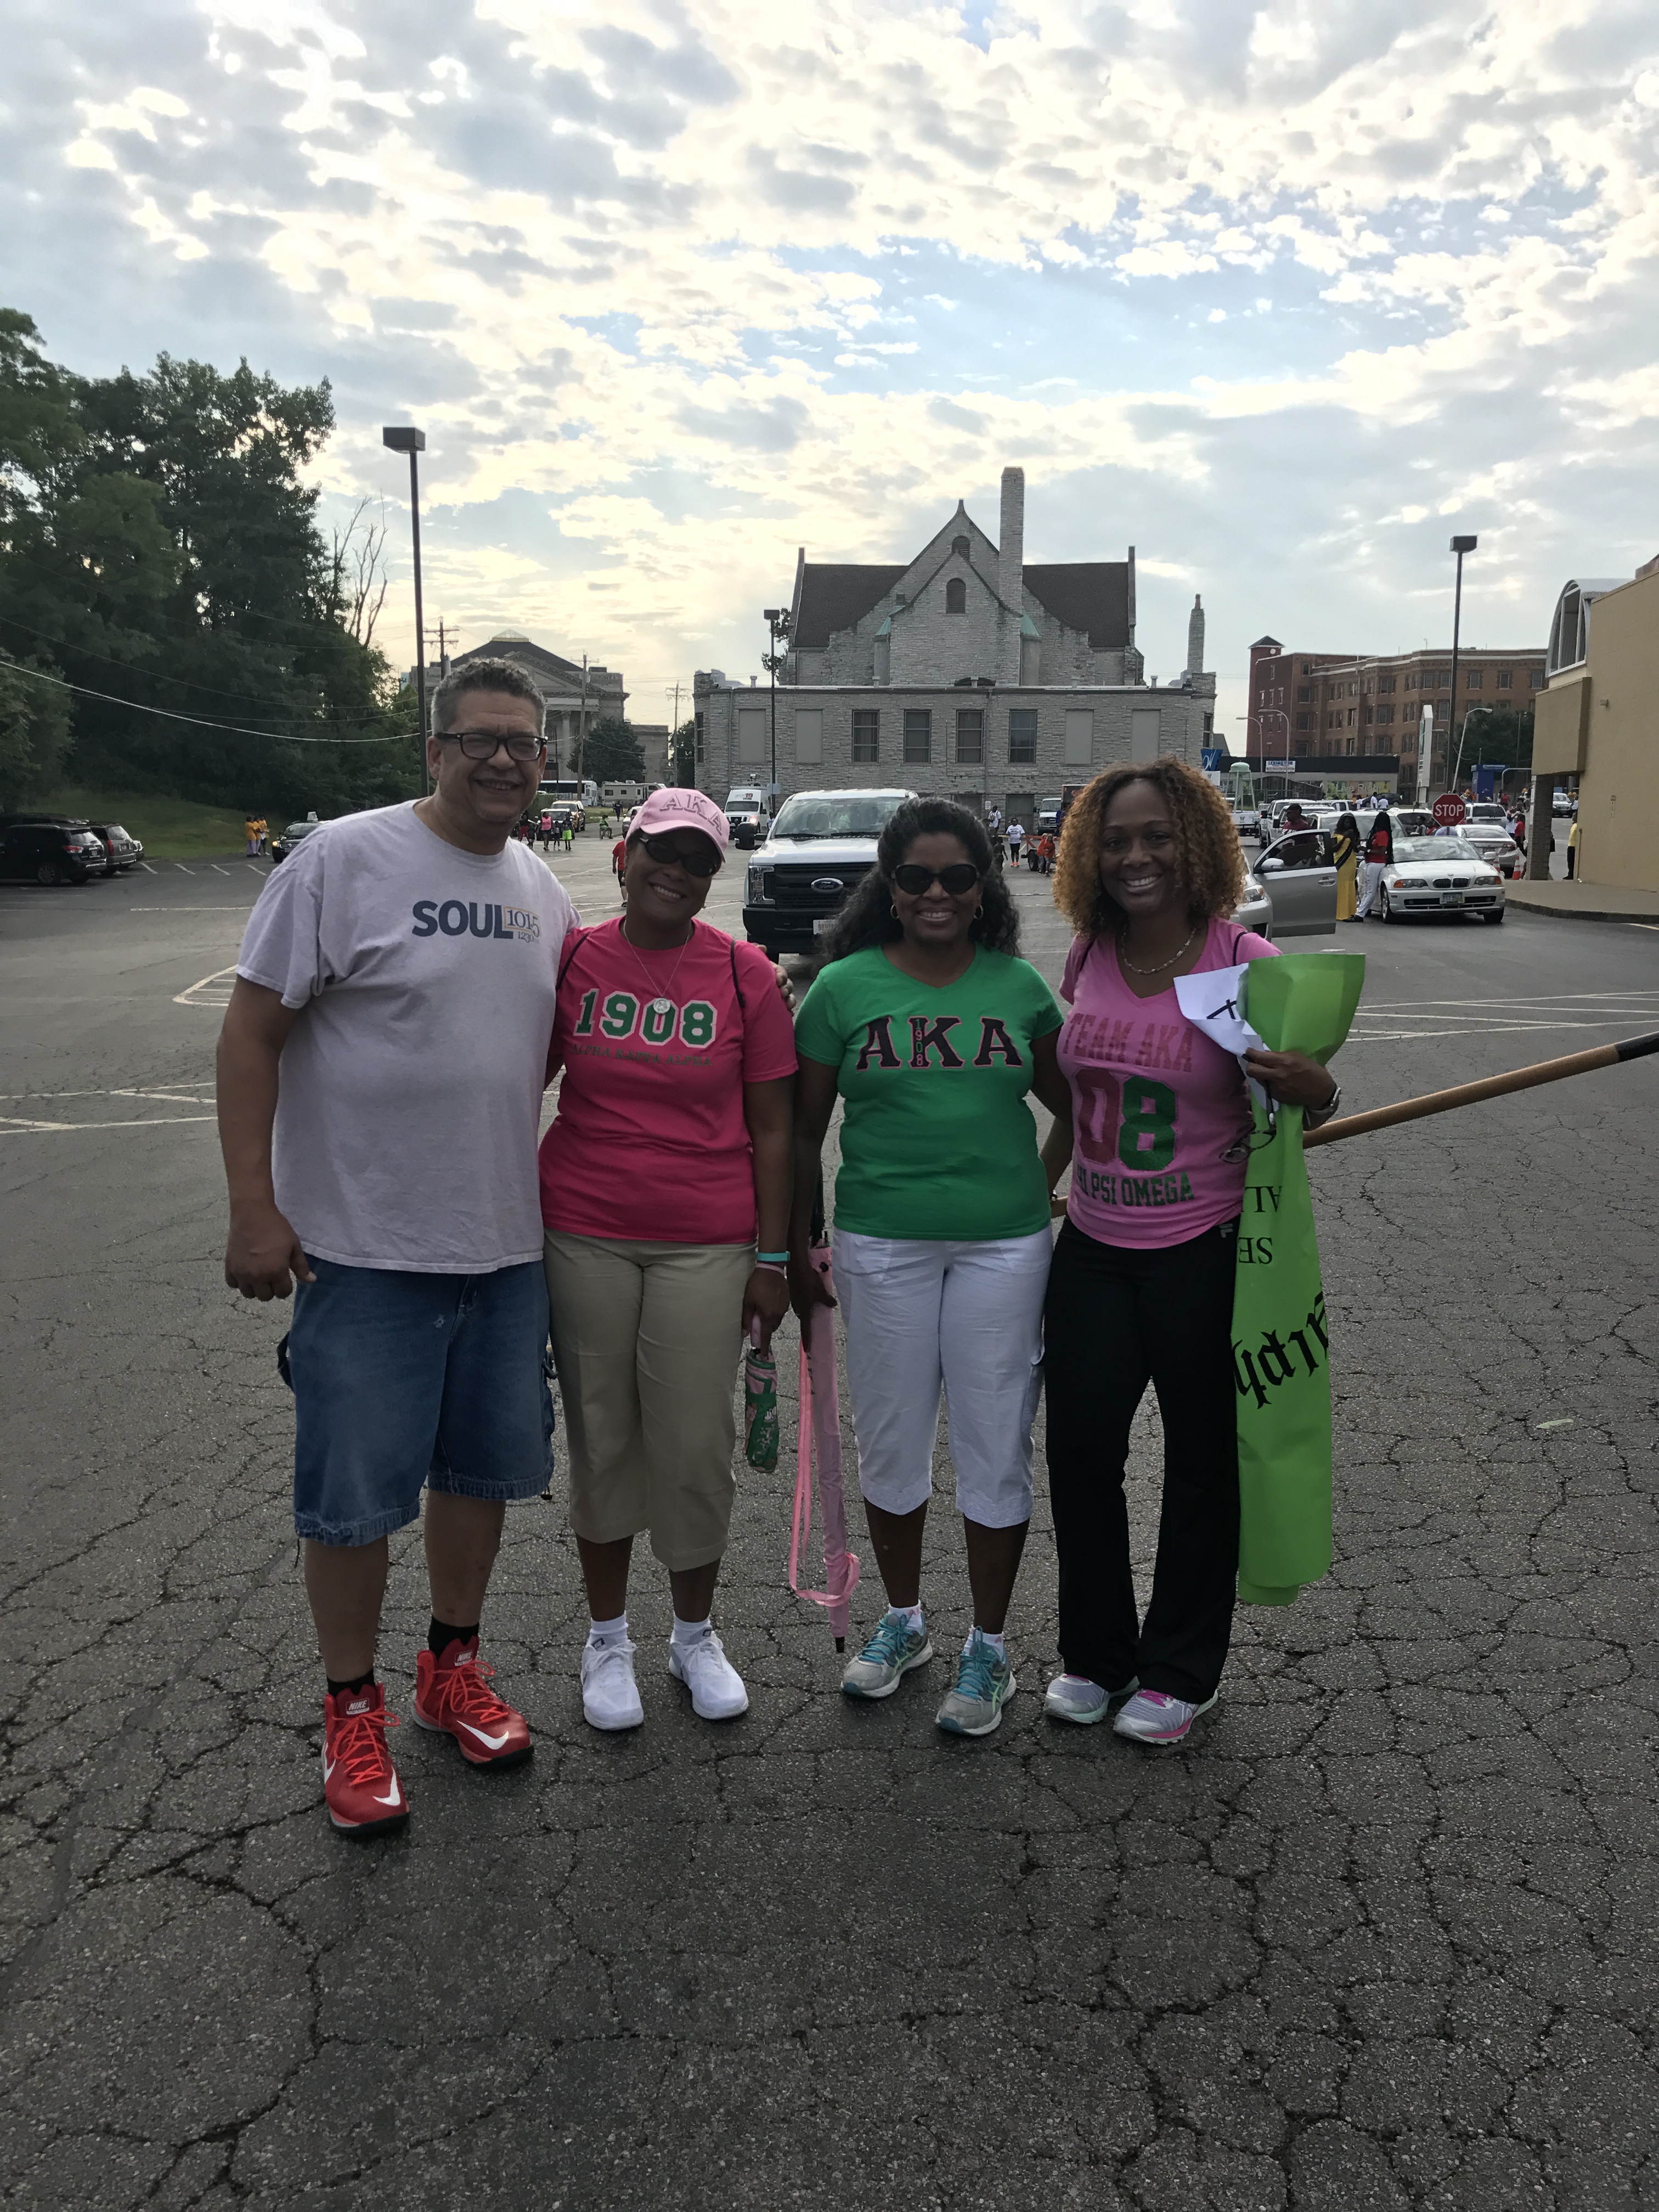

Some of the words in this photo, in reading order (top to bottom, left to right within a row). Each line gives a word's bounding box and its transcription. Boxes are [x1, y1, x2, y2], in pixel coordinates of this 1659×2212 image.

[659, 793, 723, 836] AKA
[1435, 804, 1464, 816] STOP
[412, 900, 514, 939] SOUL
[573, 988, 718, 1048] 1908
[572, 1043, 611, 1057] ALPHA
[615, 1048, 661, 1064] KAPPA
[665, 1054, 712, 1066] ALPHA
[856, 1015, 1023, 1071] AKA
[1062, 1013, 1135, 1063] TEAM
[1135, 1022, 1194, 1073] AKA
[1073, 1068, 1177, 1171] 08
[1090, 1171, 1118, 1205] PSI
[1121, 1171, 1195, 1207] OMEGA
[1242, 1186, 1283, 1213] AL
[457, 1651, 472, 1662] NIKE
[348, 1700, 368, 1711] NIKE
